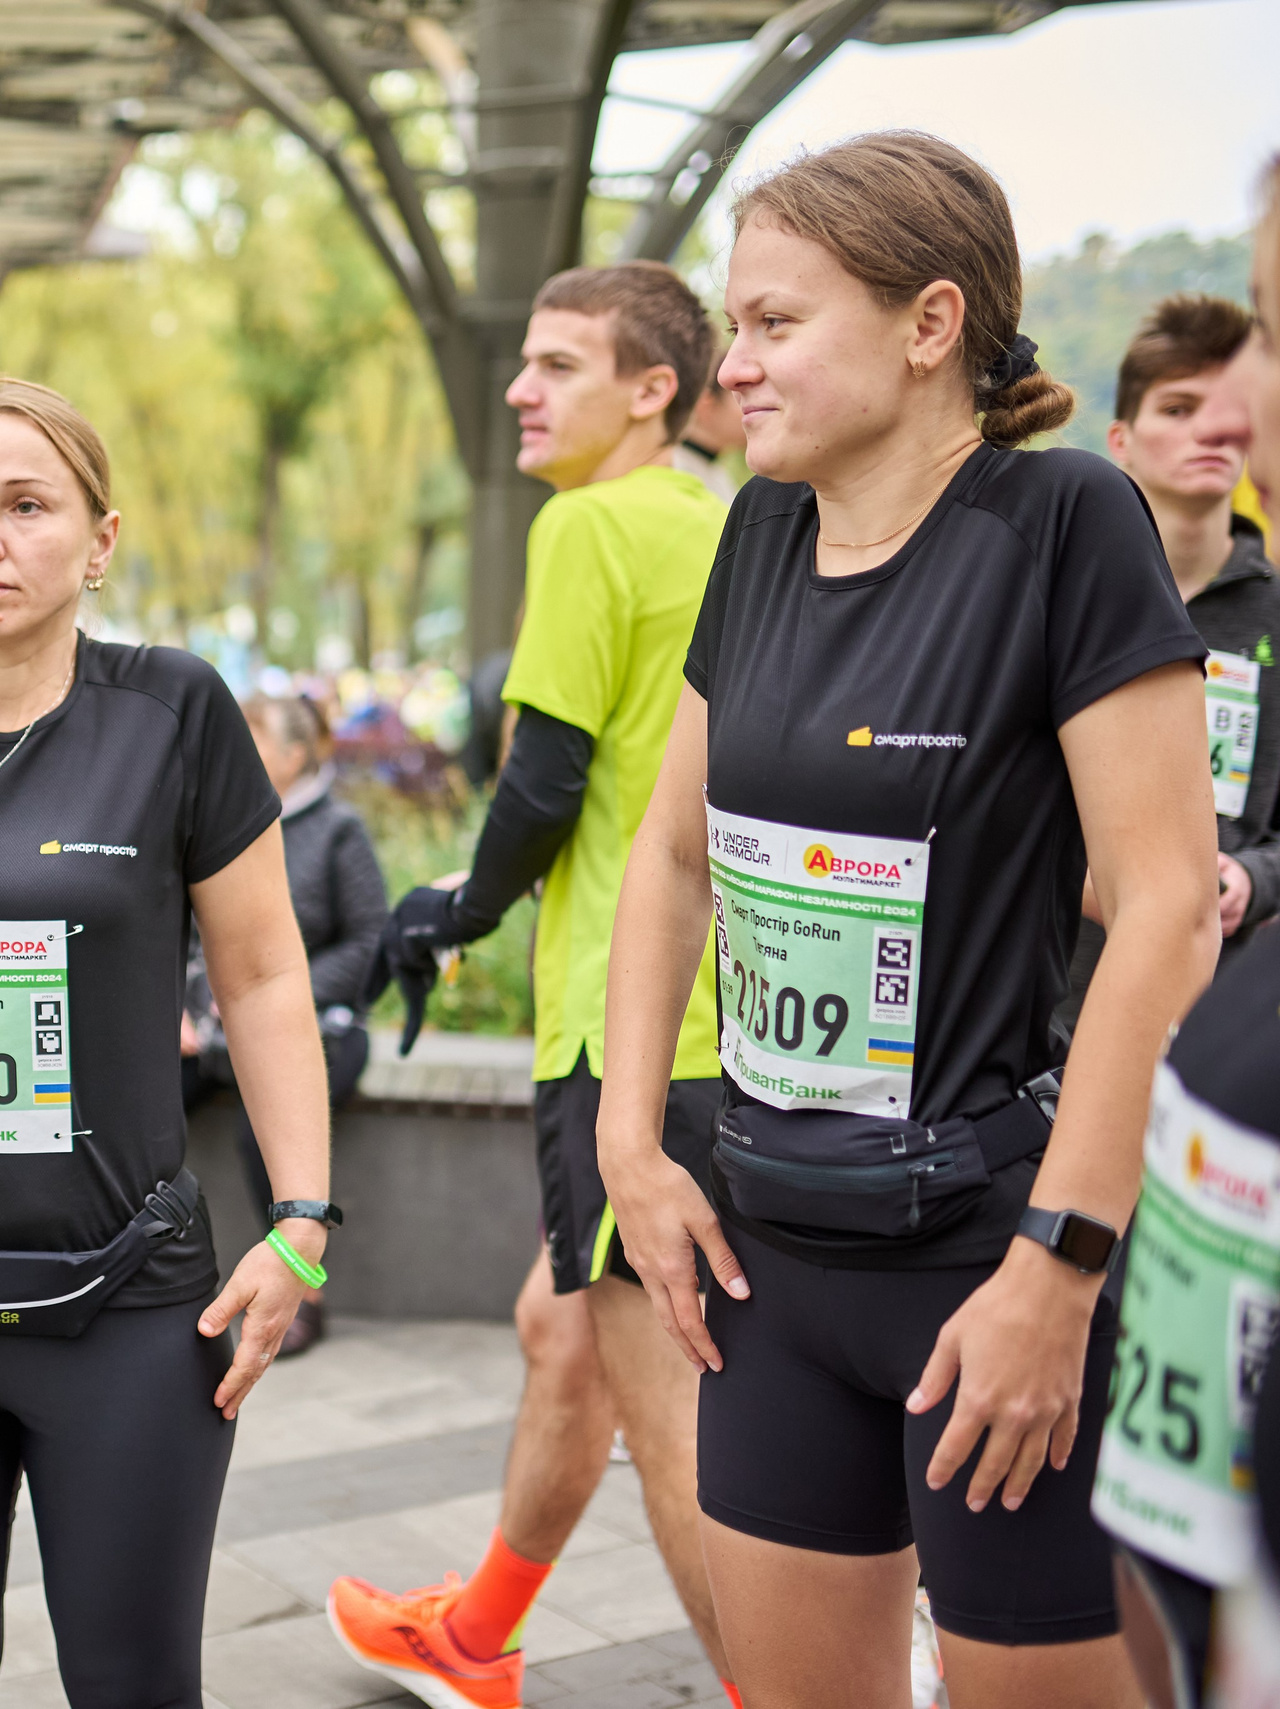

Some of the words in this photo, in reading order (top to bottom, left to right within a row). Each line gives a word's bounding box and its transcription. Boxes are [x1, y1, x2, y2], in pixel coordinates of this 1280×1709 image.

[874, 734, 918, 748] смарт
[62, 843, 99, 854] смарт
[99, 844, 138, 858] простір
[723, 830, 759, 851] UNDER
[723, 842, 770, 866] ARMOUR
[832, 874, 902, 889] МУЛЬТИМАРКЕТ
[755, 884, 797, 901] МАРАФОН
[798, 893, 881, 914] НЕЗЛАМНОСТІ
[883, 905, 917, 918] 2024
[750, 908, 789, 936] Простір
[793, 919, 841, 942] GoRun
[36, 974, 62, 983] 2024
[734, 959, 849, 1057] 21509
[737, 1053, 843, 1099] ПриватБанк
[0, 1311, 19, 1319] Go
[1107, 1322, 1200, 1466] 25
